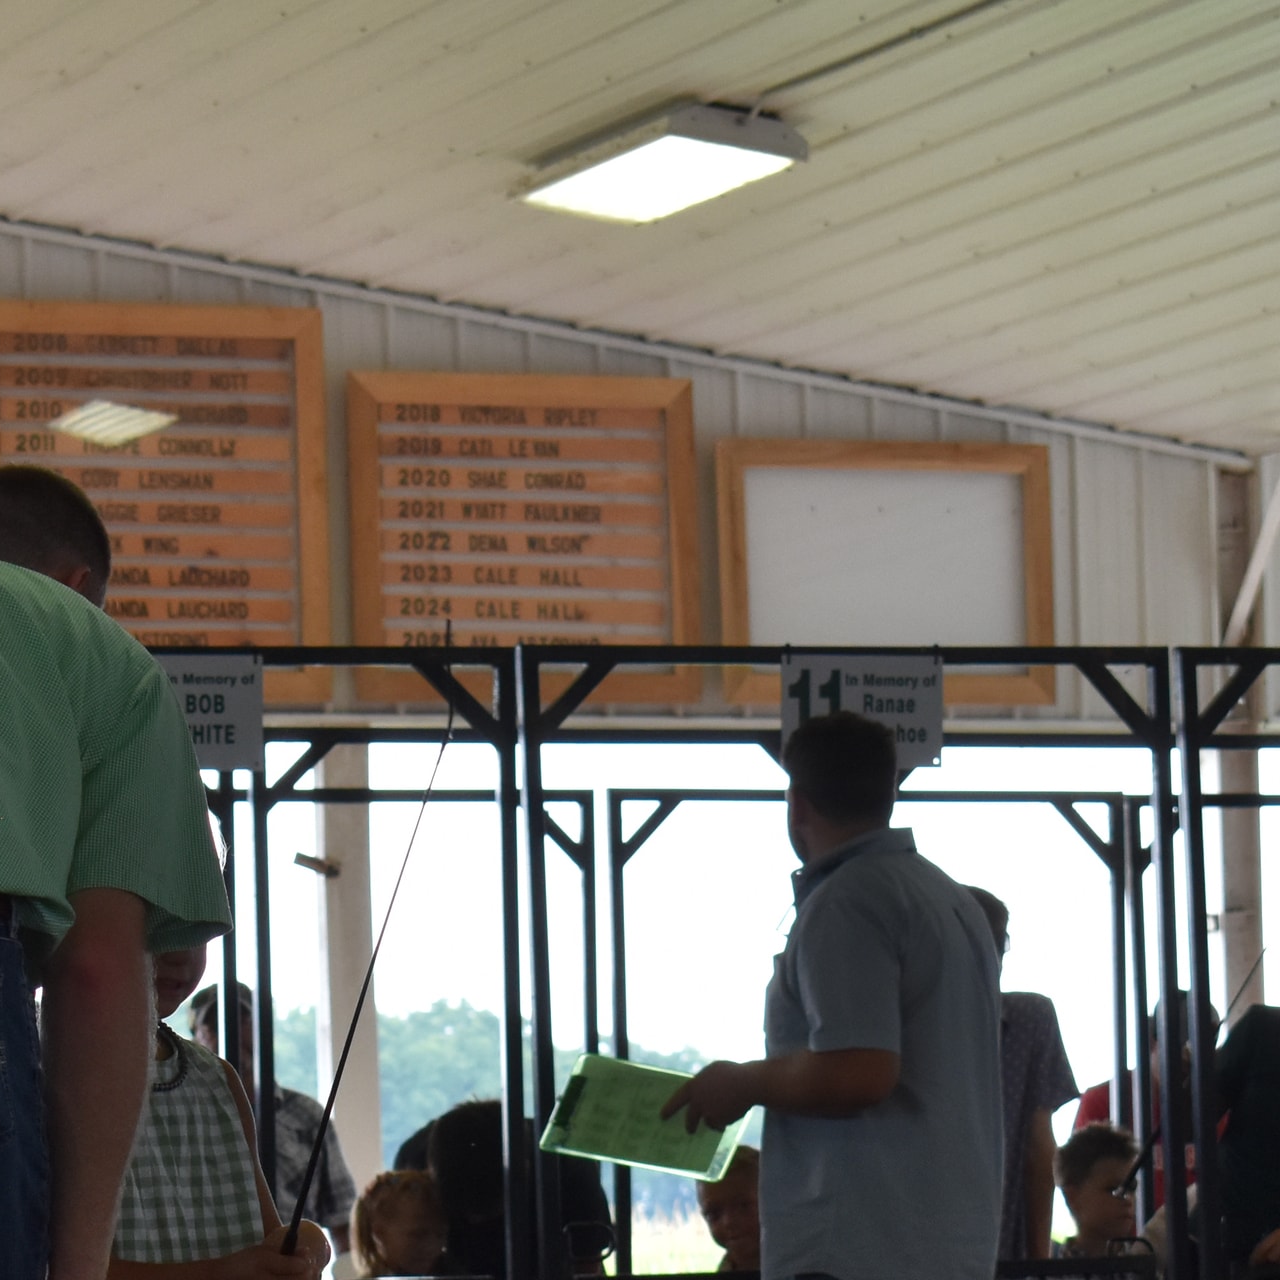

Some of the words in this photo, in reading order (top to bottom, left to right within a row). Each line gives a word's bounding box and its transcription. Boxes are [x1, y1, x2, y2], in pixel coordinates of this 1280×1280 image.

[16, 401, 62, 418] 2010
[396, 405, 440, 422] 2018
[460, 406, 526, 424] VICTORIA
[16, 434, 55, 451] 2011
[397, 438, 442, 455] 2019
[509, 440, 527, 456] LE
[139, 471, 214, 490] LENSMAN
[398, 469, 450, 486] 2020
[468, 471, 508, 488] SHAE
[524, 472, 586, 490] CONRAD
[398, 501, 444, 518] 2021
[462, 502, 506, 520] WYATT
[524, 504, 600, 522] FAULKNER
[399, 532, 451, 550] 2022
[526, 536, 582, 553] WILSON
[400, 565, 452, 582] 2023
[474, 566, 518, 584] CALE
[539, 568, 582, 586] HALL
[400, 598, 452, 616] 2024
[475, 600, 520, 619] CALE
[536, 601, 583, 620] HALL
[169, 675, 177, 684] n
[183, 674, 237, 687] Memory
[241, 674, 255, 684] of
[846, 675, 858, 686] In
[863, 675, 918, 689] Memory
[923, 675, 936, 686] of
[186, 694, 224, 714] BOB
[863, 695, 915, 713] Ranae
[189, 724, 235, 744] HITE
